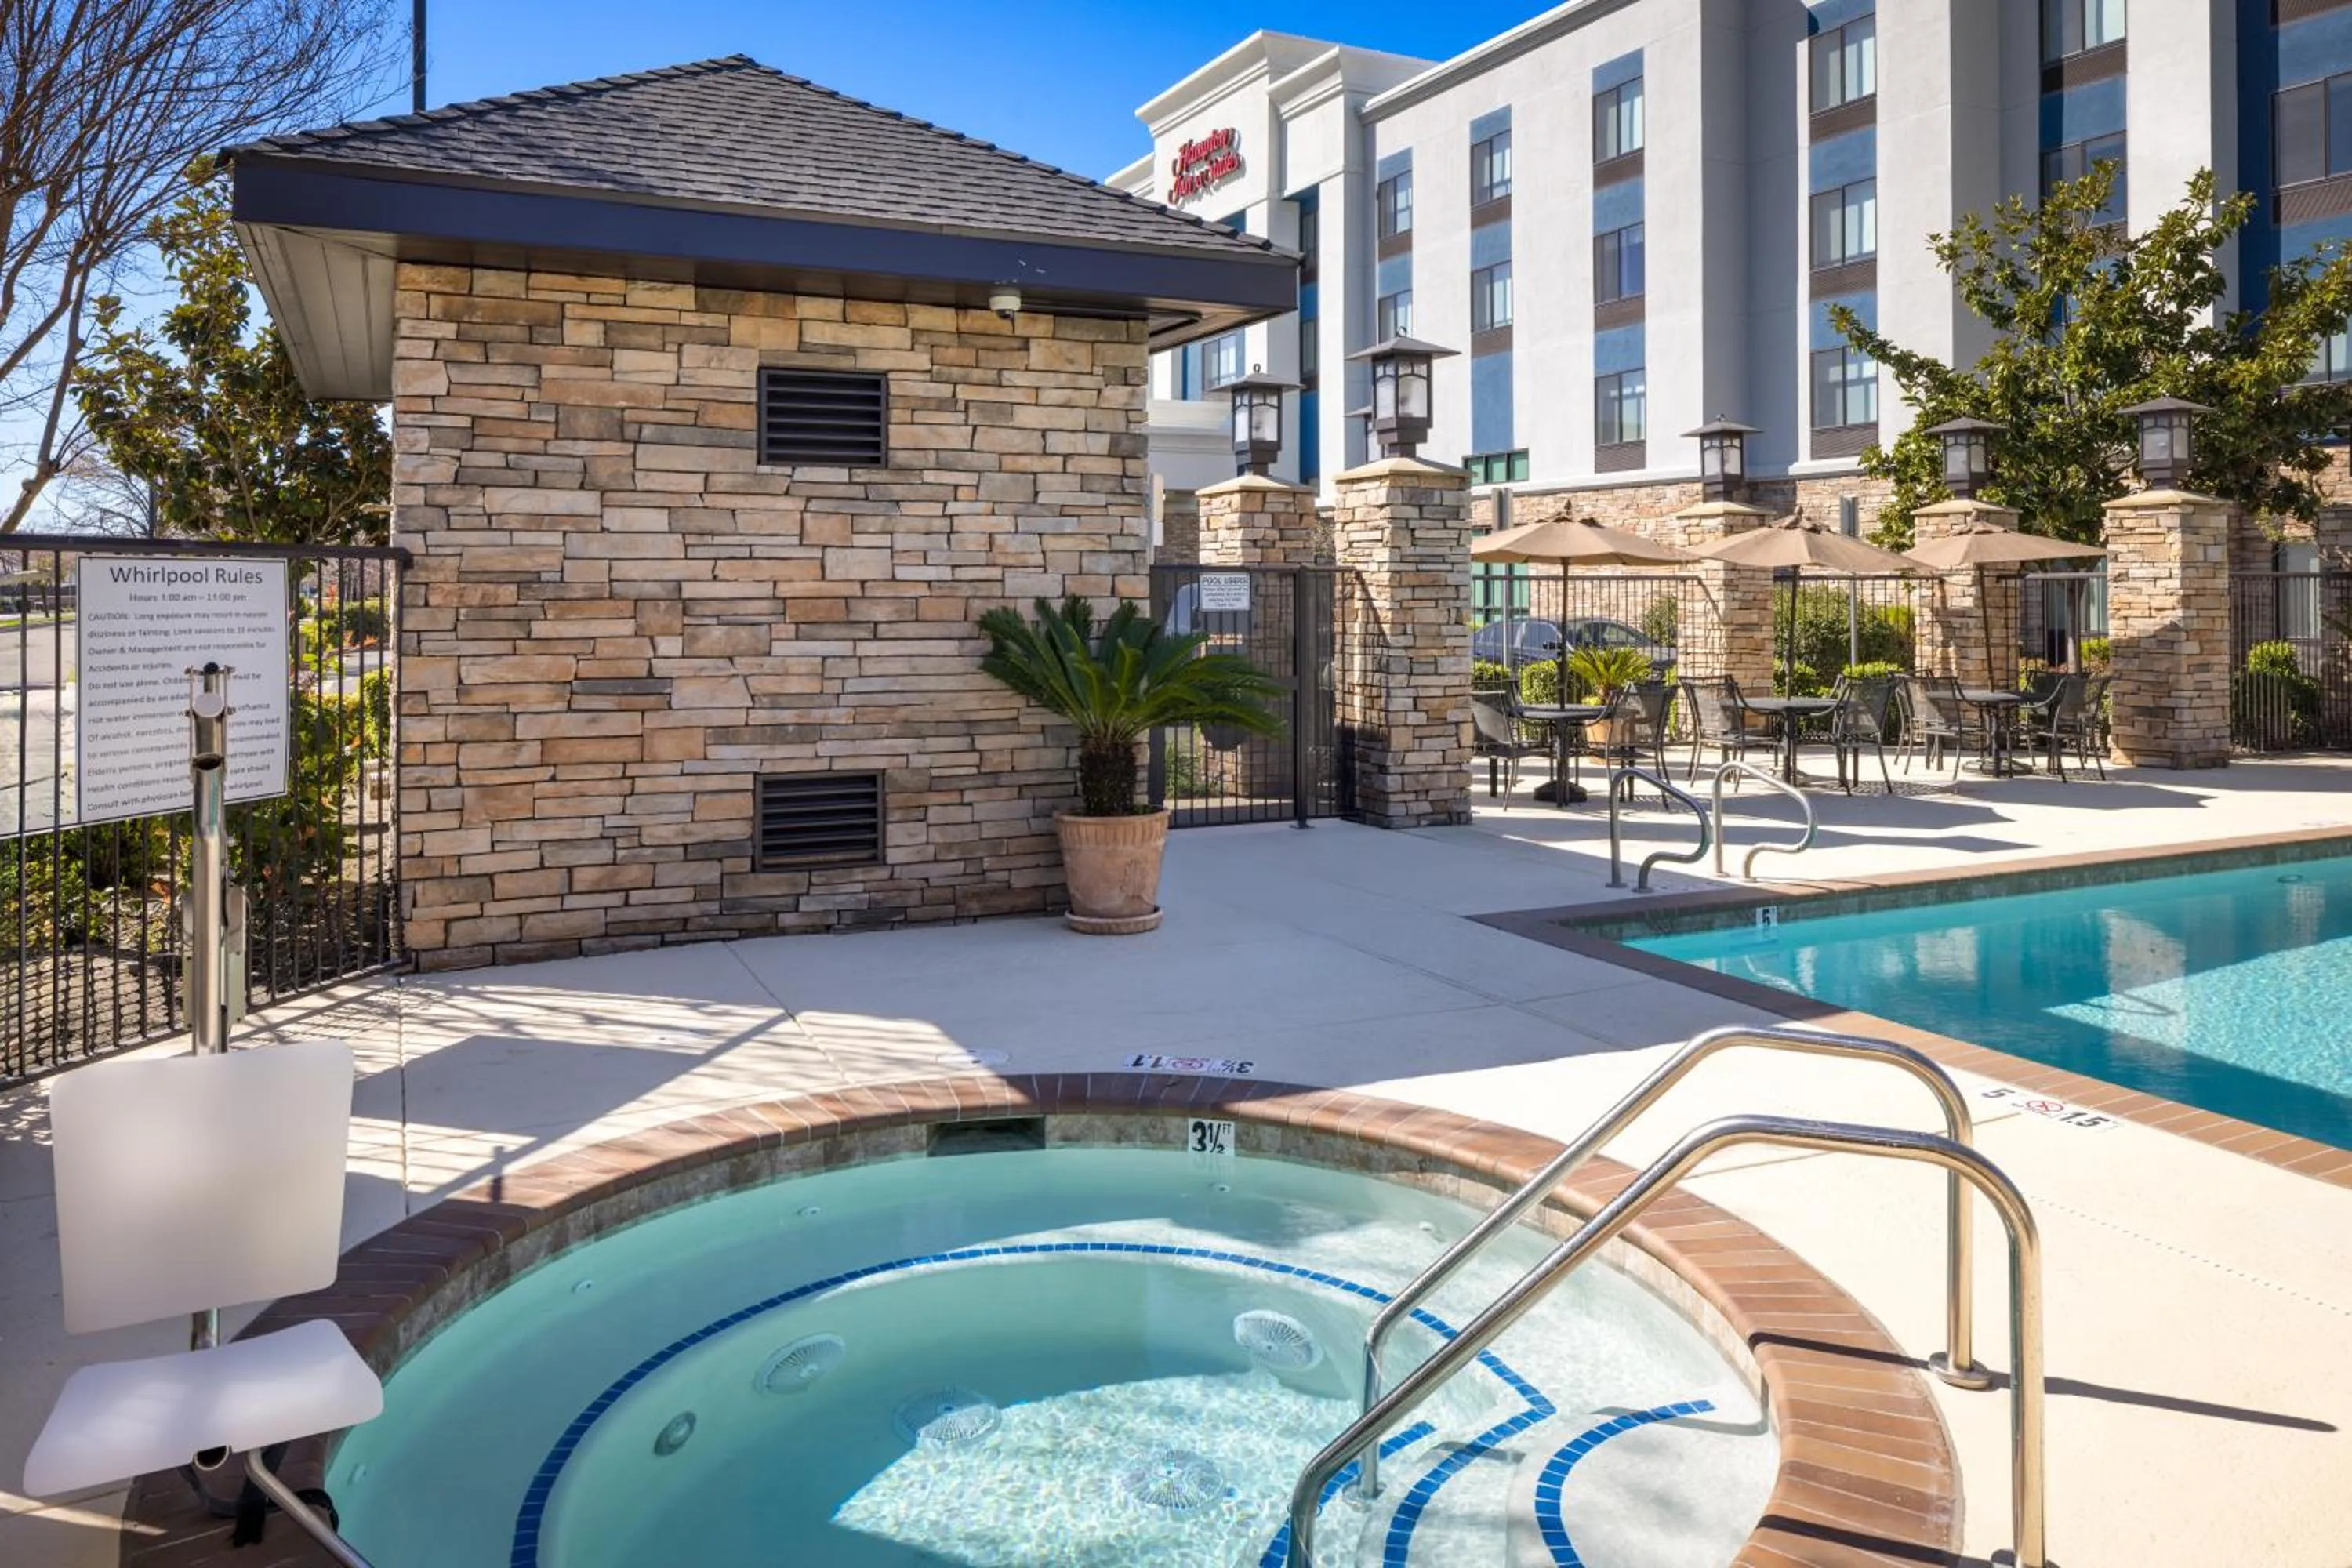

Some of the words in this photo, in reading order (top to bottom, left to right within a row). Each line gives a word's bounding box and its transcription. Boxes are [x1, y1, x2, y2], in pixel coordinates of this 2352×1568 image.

[1172, 127, 1236, 176] Hampton
[1167, 173, 1195, 205] Inn
[109, 565, 209, 586] Whirlpool
[215, 567, 263, 584] Rules
[129, 593, 158, 602] Hours
[232, 594, 247, 603] pm
[87, 647, 117, 655] Owner
[128, 645, 182, 655] Management
[87, 663, 129, 672] Accidents
[87, 681, 101, 690] Do
[87, 696, 145, 707] accompanied
[146, 695, 156, 704] by
[87, 716, 103, 724] Hot
[105, 714, 131, 723] water
[87, 733, 99, 742] Of
[87, 768, 117, 776] Elderly
[87, 783, 115, 793] Health
[87, 800, 118, 811] Consult
[122, 797, 140, 806] with
[1980, 1087, 2016, 1098] 5
[2059, 1111, 2111, 1127] 1.5
